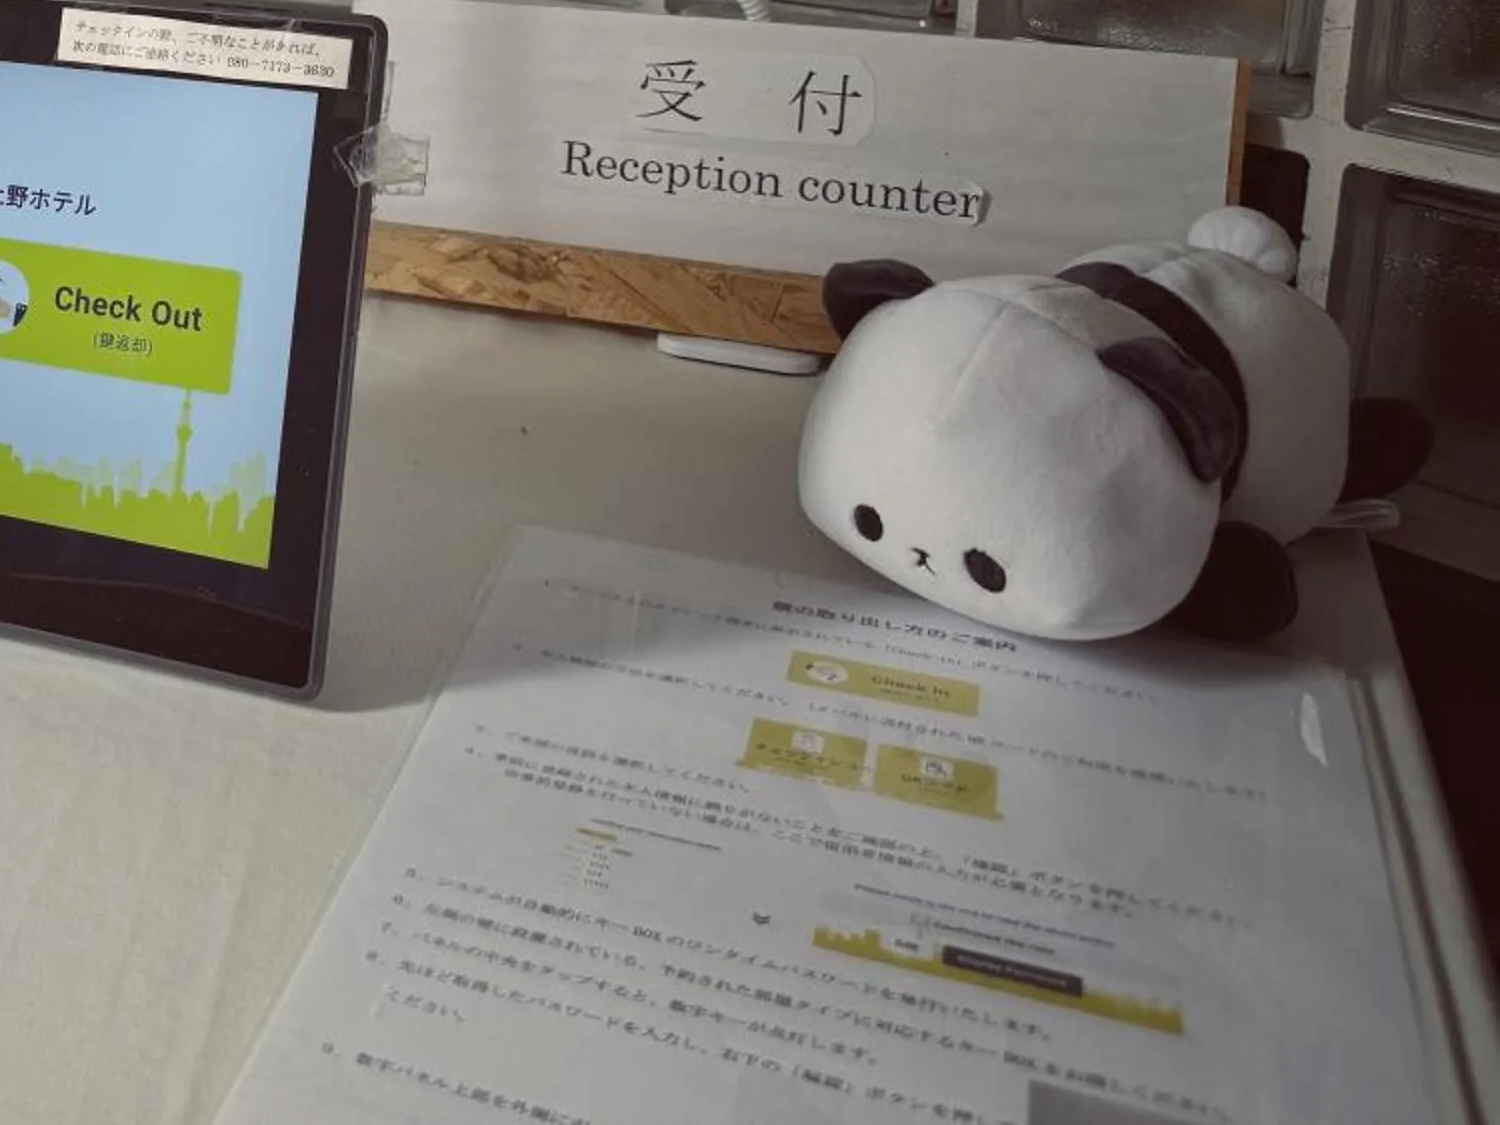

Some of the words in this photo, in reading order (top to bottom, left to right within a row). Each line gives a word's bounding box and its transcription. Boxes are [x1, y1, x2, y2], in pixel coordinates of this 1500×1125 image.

[561, 139, 783, 198] Reception
[798, 175, 983, 219] counter
[54, 286, 141, 322] Check
[151, 299, 203, 333] Out
